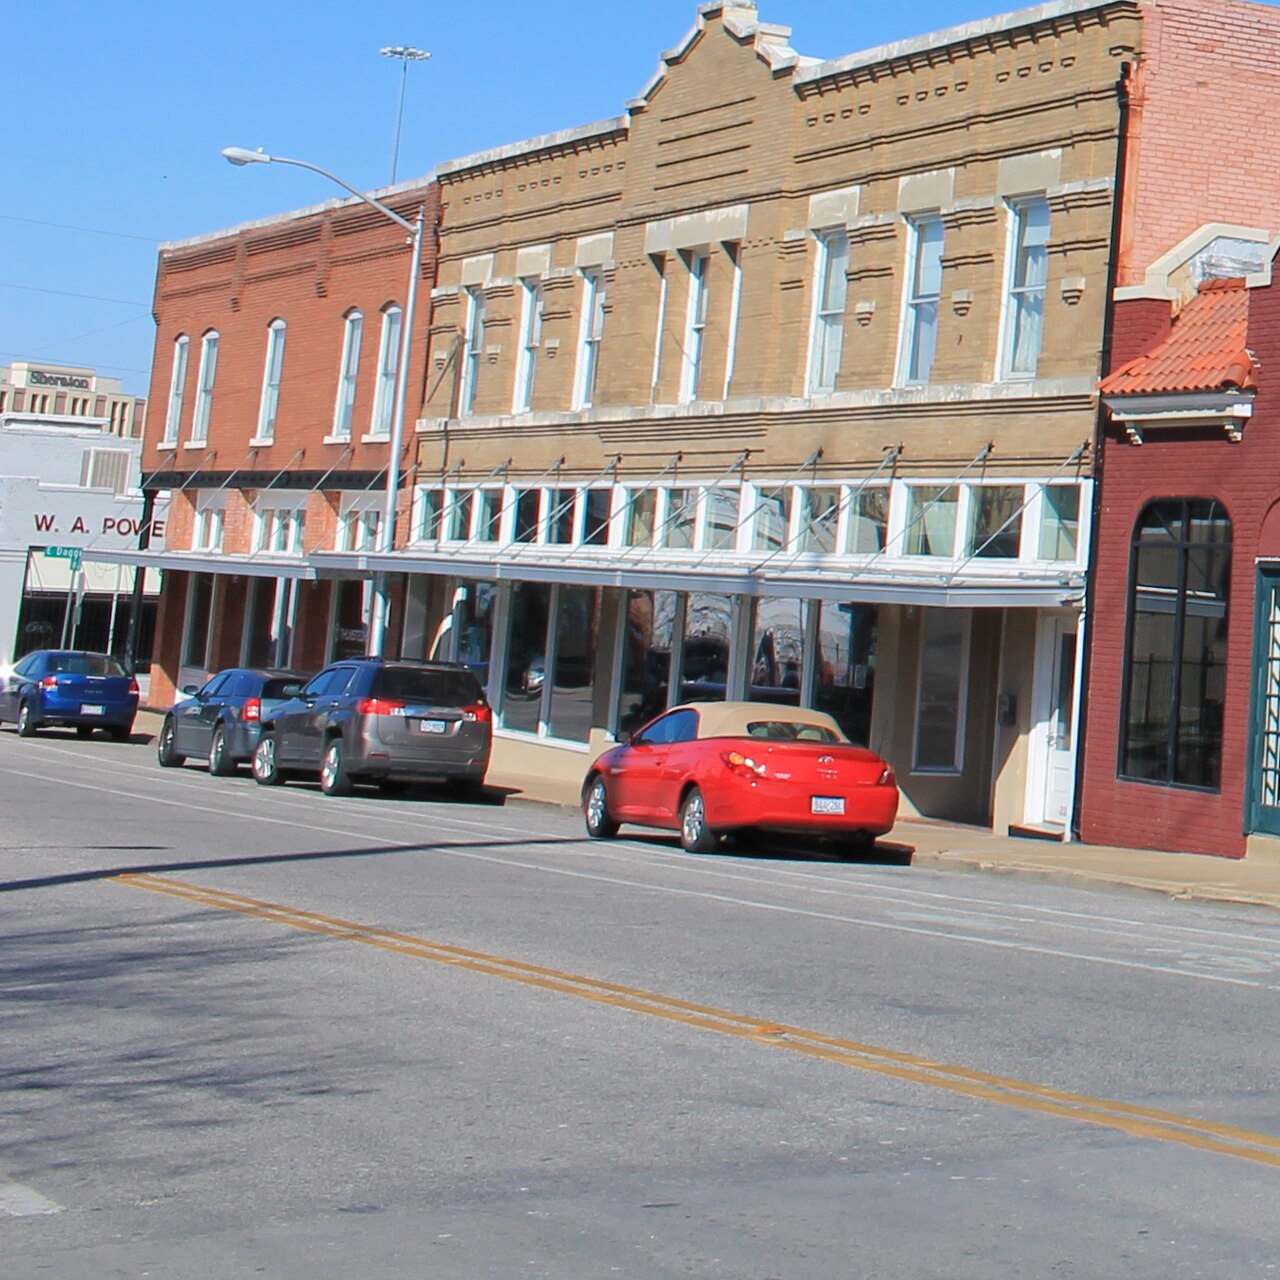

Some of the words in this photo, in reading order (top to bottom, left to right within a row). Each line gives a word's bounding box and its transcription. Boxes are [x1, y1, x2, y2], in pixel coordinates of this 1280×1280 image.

[31, 371, 88, 389] Sheraton
[34, 514, 59, 533] W.
[70, 516, 90, 534] A.
